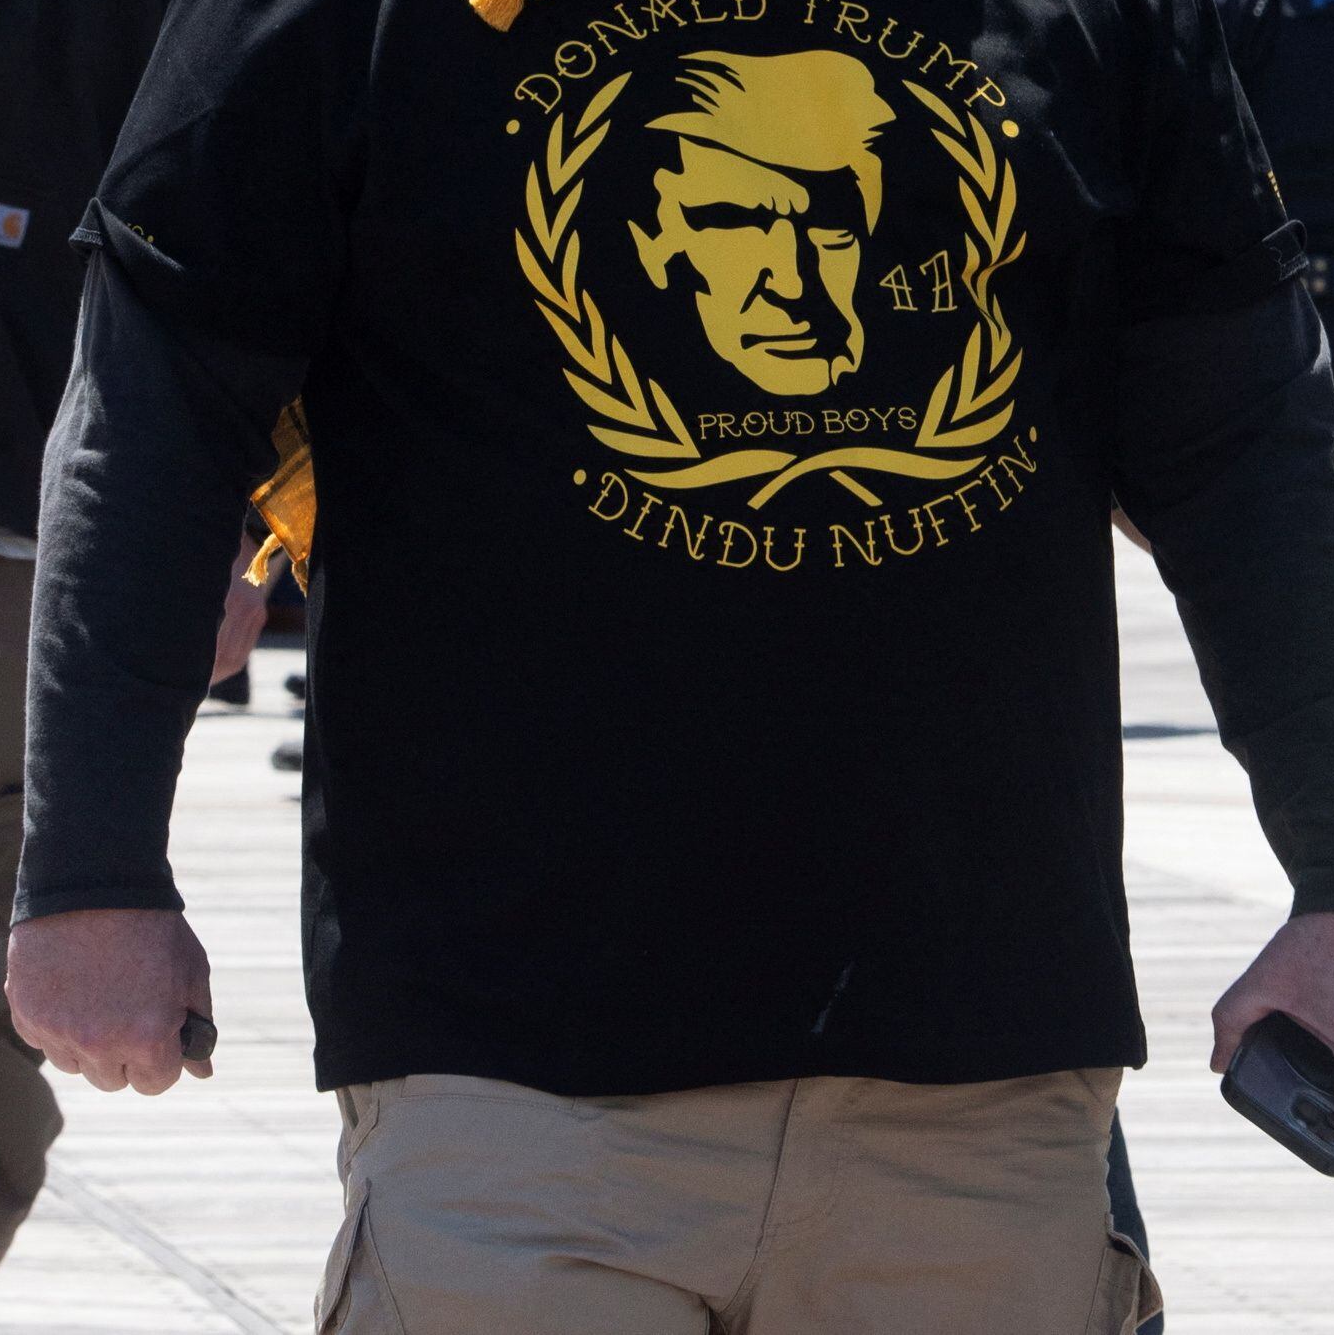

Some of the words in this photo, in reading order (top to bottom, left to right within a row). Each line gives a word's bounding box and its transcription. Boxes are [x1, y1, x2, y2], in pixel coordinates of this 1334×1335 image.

[879, 249, 958, 313] 47
[698, 411, 815, 440] PROUD
[823, 407, 917, 434] BOYS
[587, 472, 806, 571] DINDU
[829, 436, 1038, 567] NUFFIN
